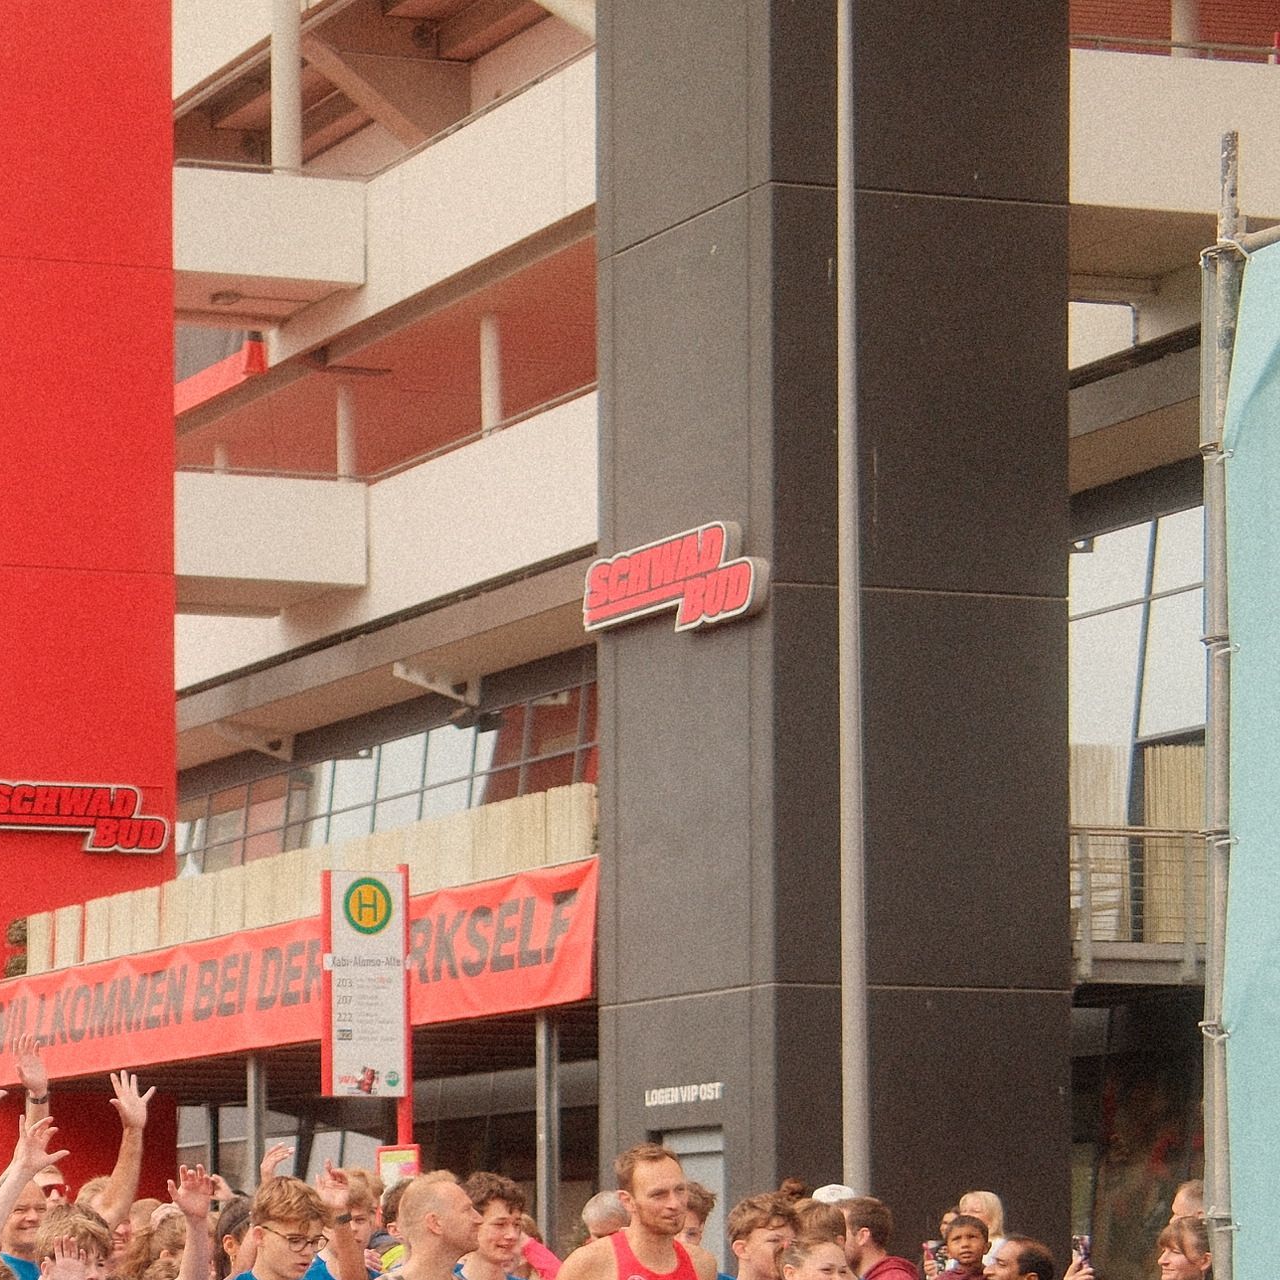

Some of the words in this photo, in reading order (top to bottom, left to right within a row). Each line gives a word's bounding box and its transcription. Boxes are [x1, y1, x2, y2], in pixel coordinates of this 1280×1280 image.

[587, 527, 723, 606] SCHWAD
[679, 561, 751, 625] BUD
[91, 817, 166, 850] BUD
[192, 954, 249, 1017] BEI
[257, 938, 322, 1009] DER
[409, 887, 578, 986] RKSELF
[336, 977, 353, 988] 203
[336, 994, 353, 1006] 207
[336, 1012, 353, 1023] 222
[645, 1087, 679, 1107] LOGEN
[680, 1084, 699, 1102] VIP
[699, 1082, 722, 1100] OST
